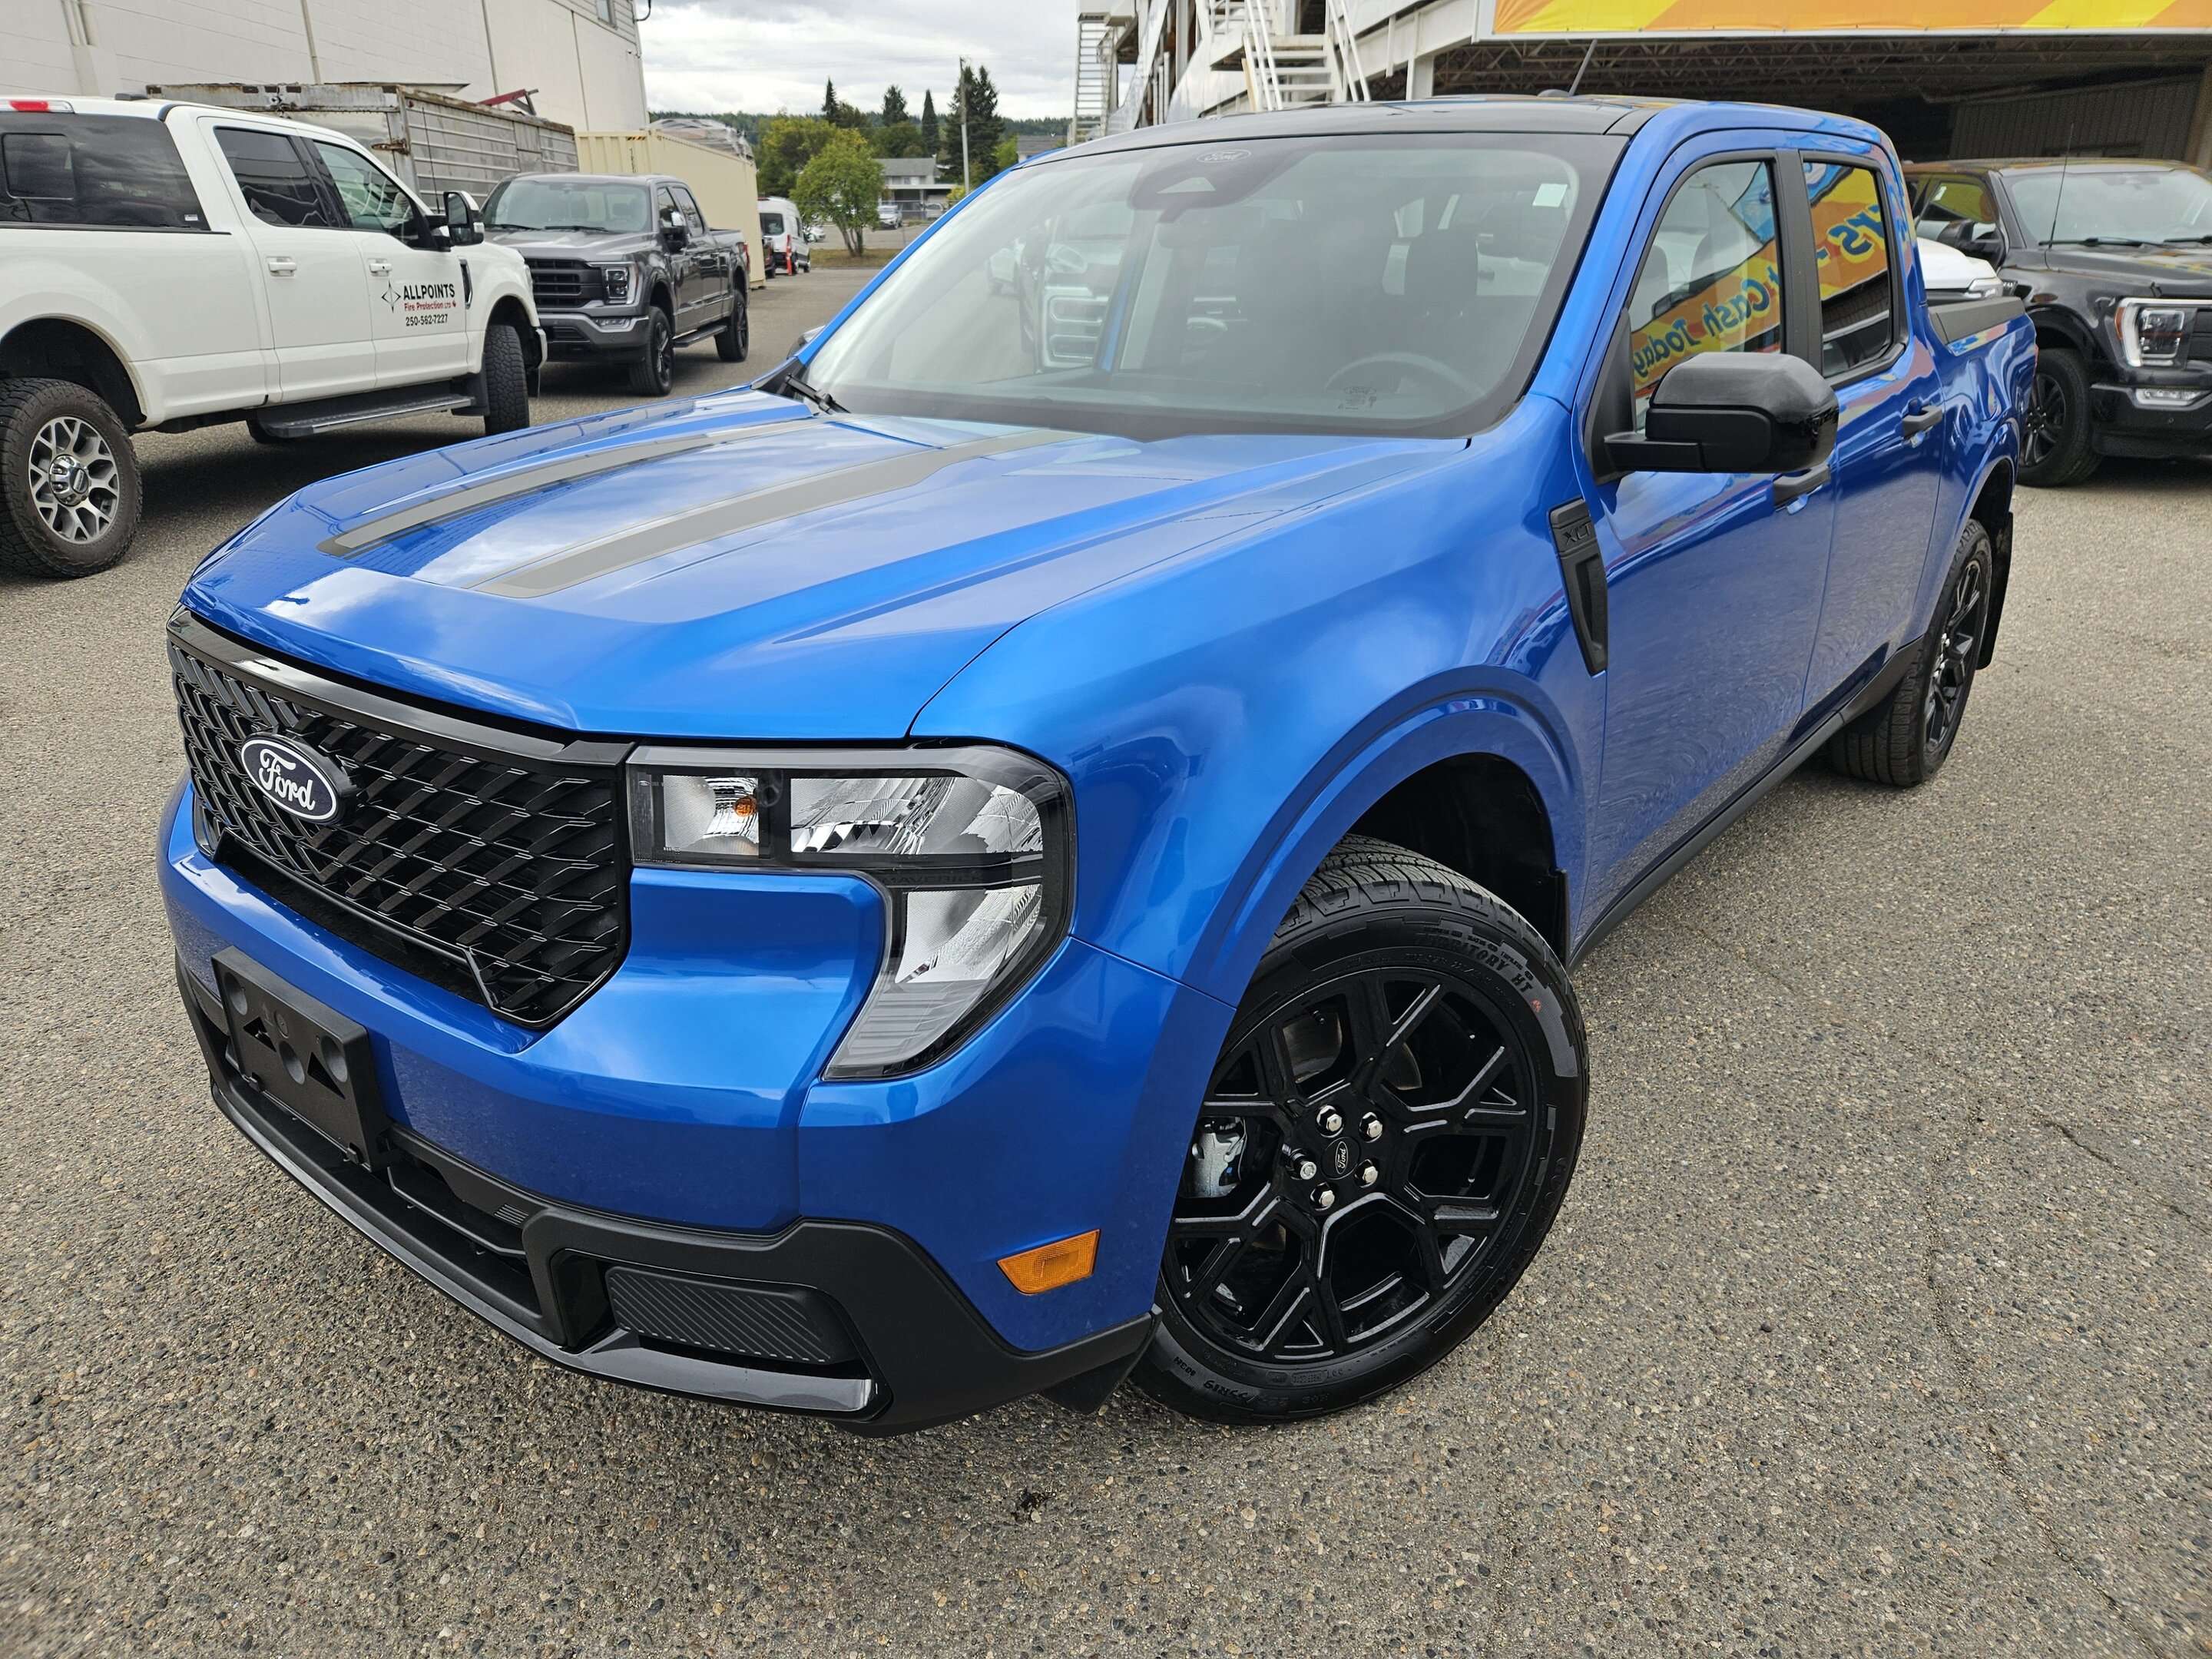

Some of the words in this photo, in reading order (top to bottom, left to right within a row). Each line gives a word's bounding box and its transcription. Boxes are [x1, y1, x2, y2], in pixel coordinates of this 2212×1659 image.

[403, 283, 455, 300] ALLPOINTS
[404, 303, 415, 311] Fire
[416, 300, 444, 310] Protection
[406, 314, 448, 326] 250-562-7227
[1562, 522, 1591, 545] XLT
[259, 749, 316, 810] Ford
[1511, 973, 1533, 992] HT
[1337, 1147, 1346, 1168] Ford
